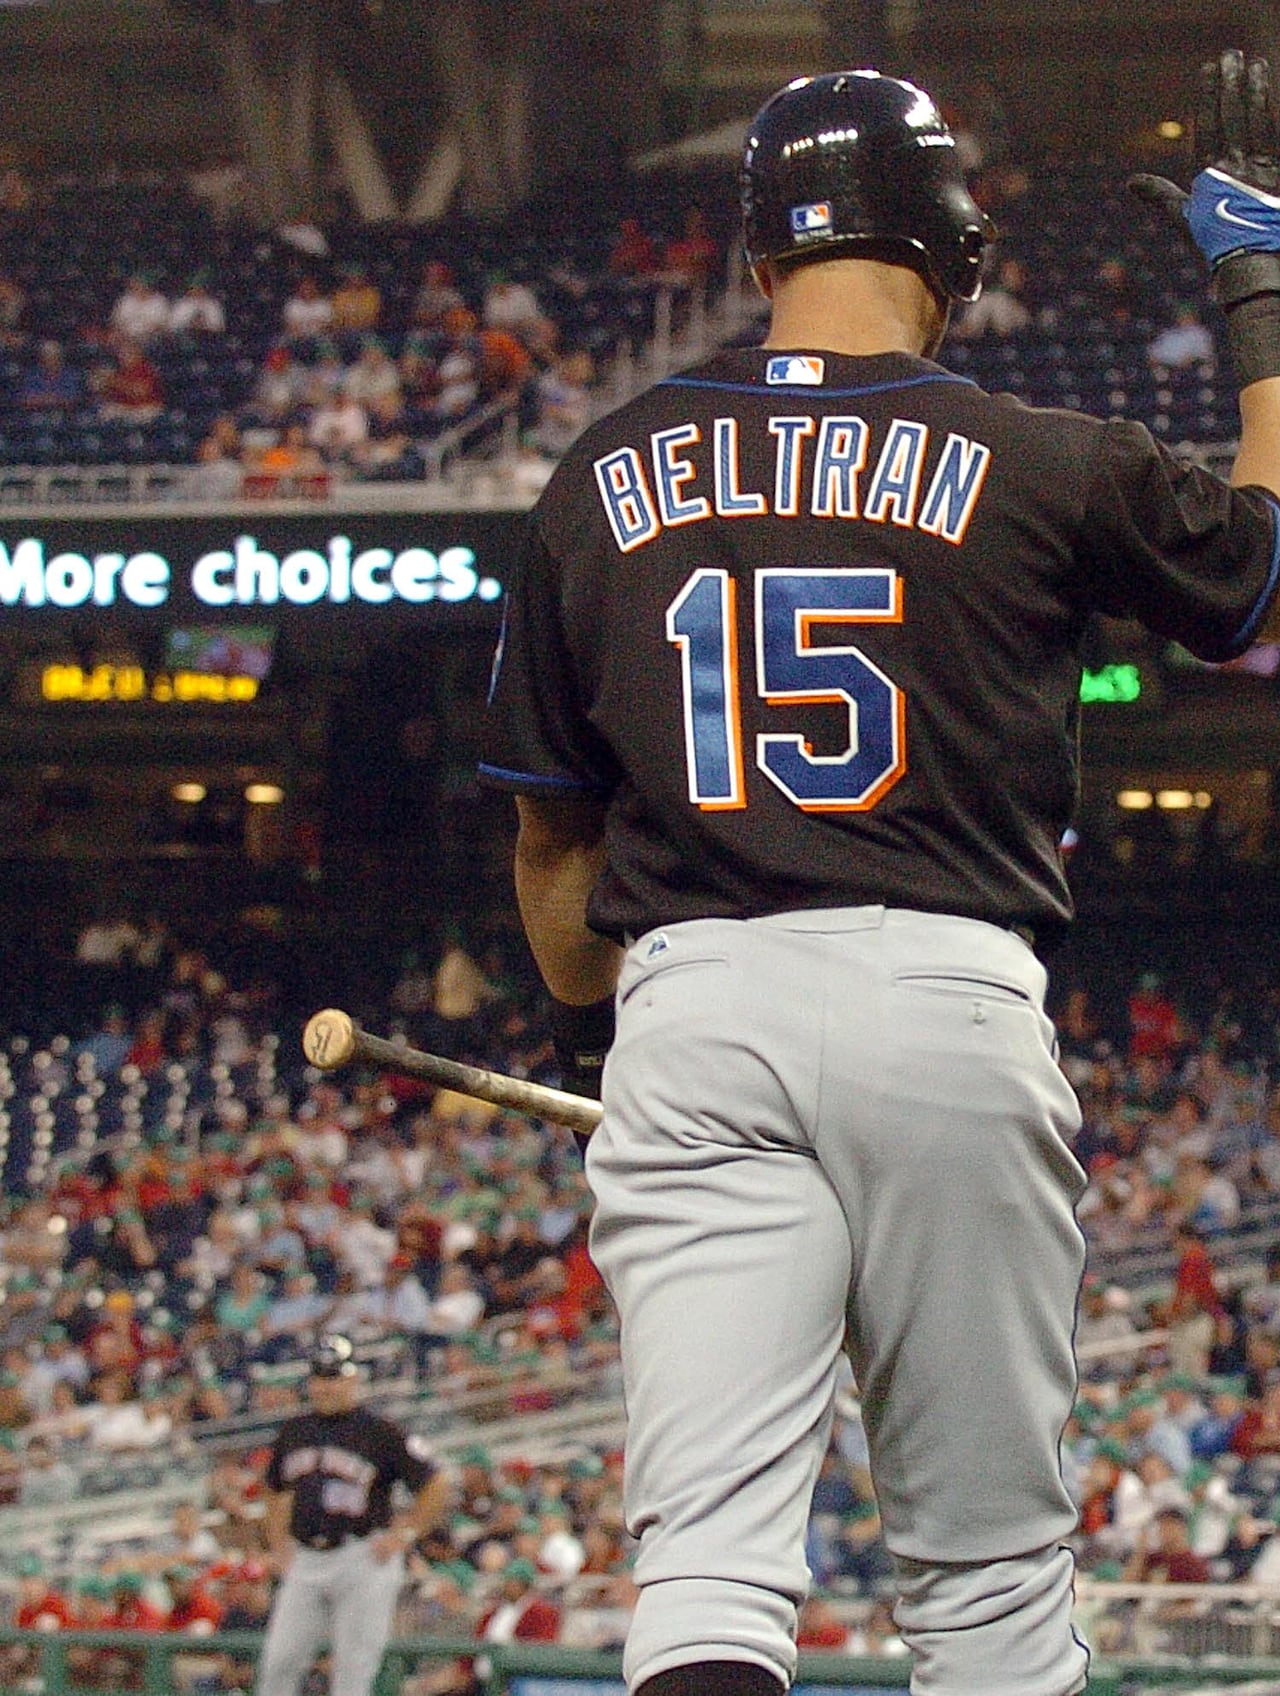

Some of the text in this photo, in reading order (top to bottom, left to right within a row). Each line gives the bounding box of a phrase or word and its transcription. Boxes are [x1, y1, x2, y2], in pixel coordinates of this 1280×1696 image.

[594, 415, 991, 553] BELTRAN
[0, 535, 501, 606] More choices.
[666, 568, 907, 812] 15
